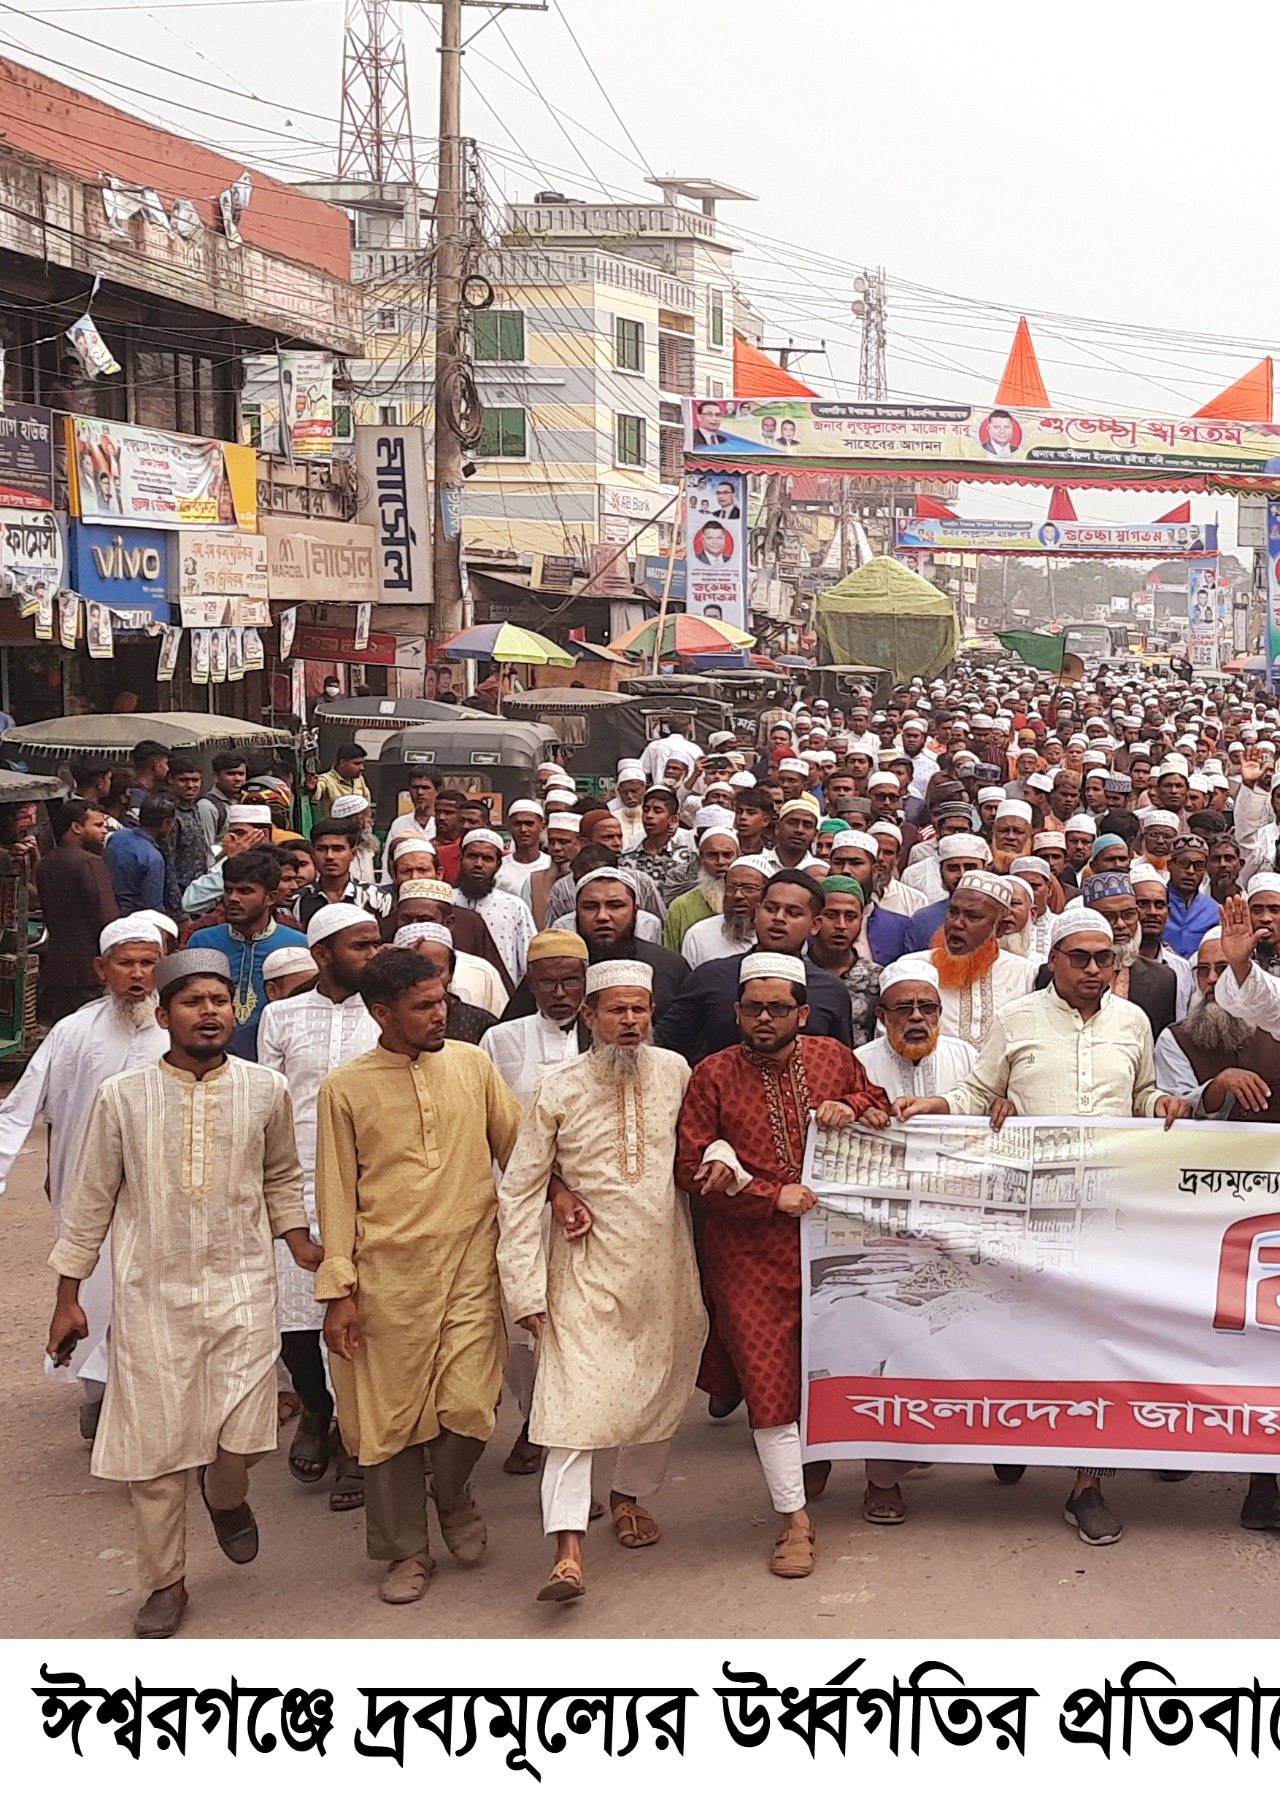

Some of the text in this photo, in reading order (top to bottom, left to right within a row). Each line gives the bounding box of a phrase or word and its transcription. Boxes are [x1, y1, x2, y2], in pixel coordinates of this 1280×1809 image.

[812, 421, 843, 433] জনাব
[951, 425, 973, 437] বাবু
[1038, 415, 1245, 448] শুভেচ্ছা স্বাগতম
[841, 439, 942, 452] সাহেবের আগমন
[376, 437, 418, 592] মার্সেল
[633, 497, 650, 511] Bank
[1065, 529, 1112, 542] শুভেচ্ছা
[92, 535, 160, 580] vivo
[847, 1393, 1112, 1429] বাংলাদেশ
